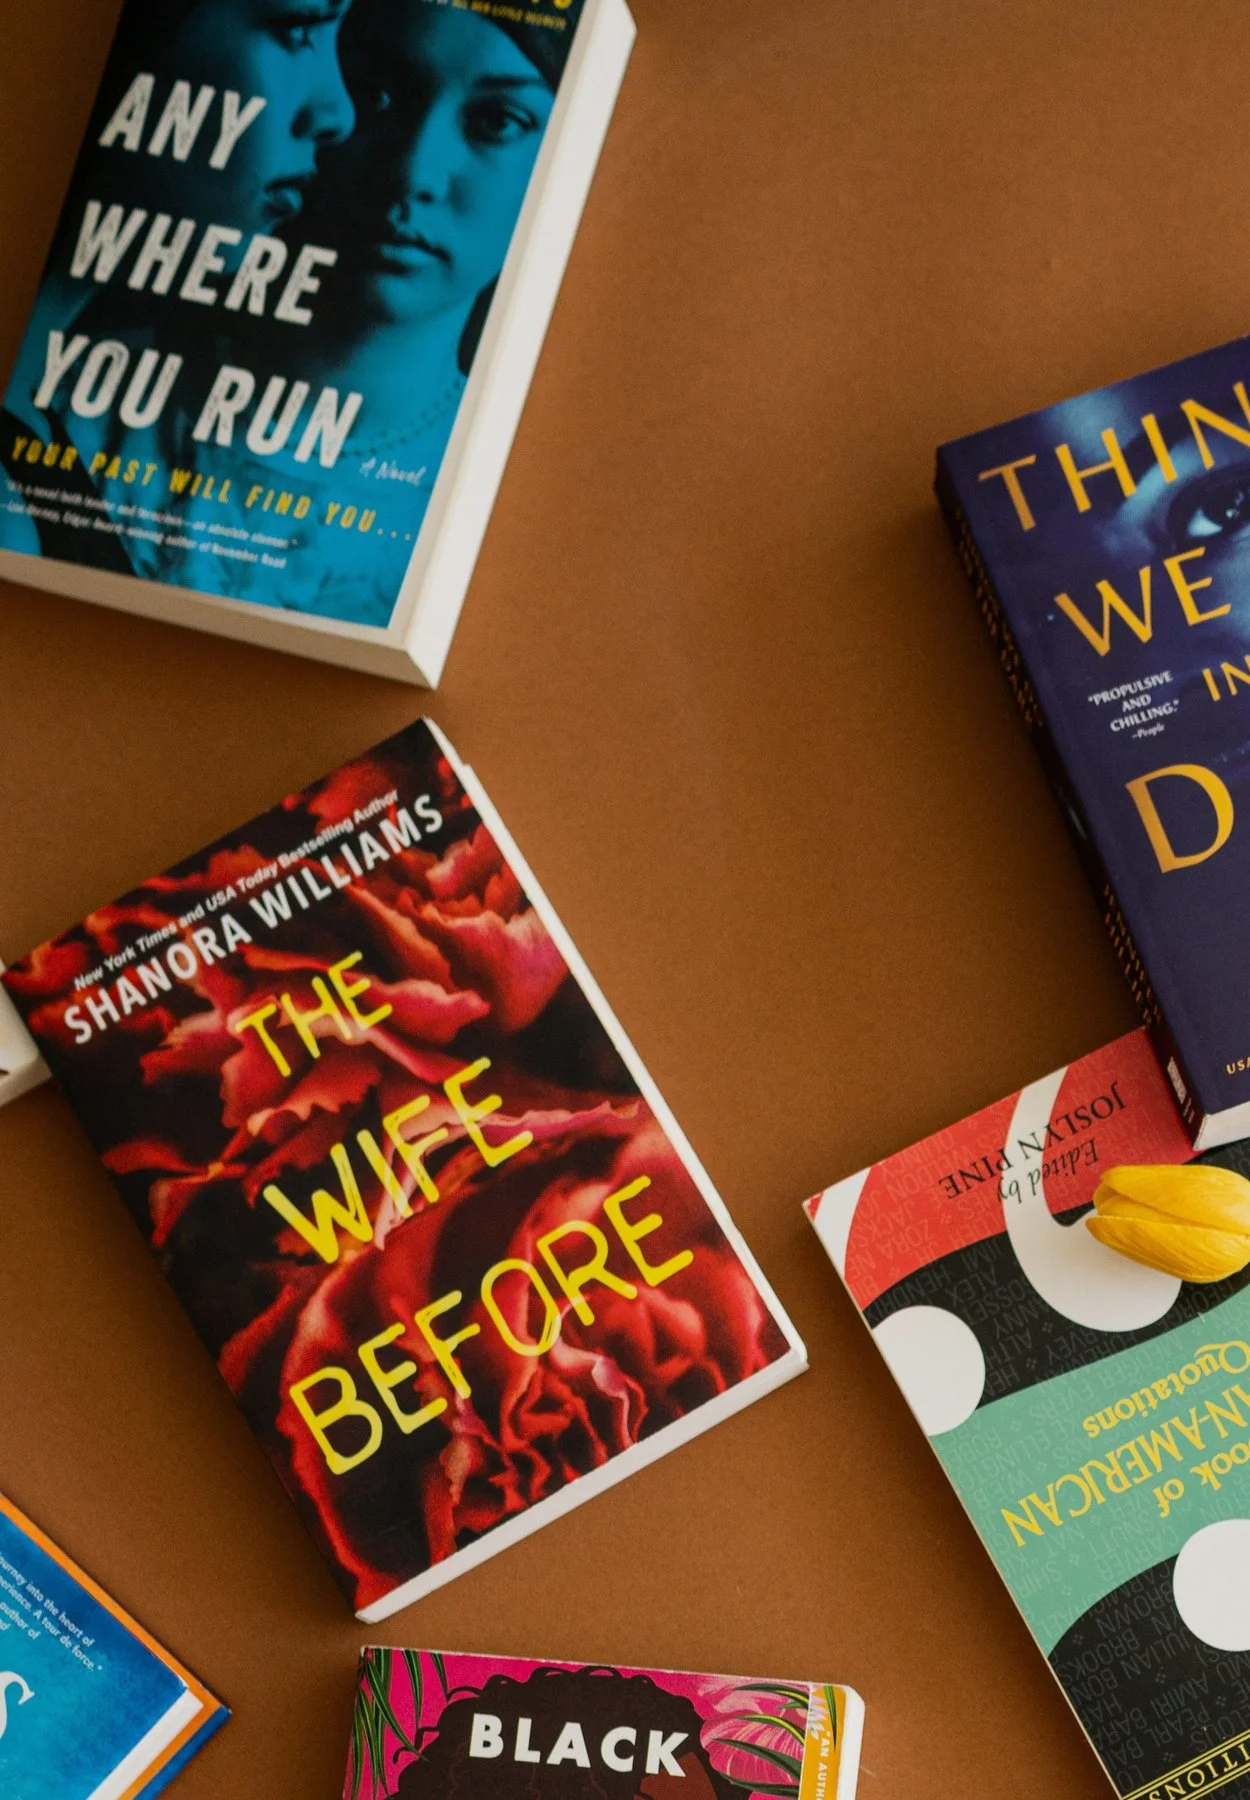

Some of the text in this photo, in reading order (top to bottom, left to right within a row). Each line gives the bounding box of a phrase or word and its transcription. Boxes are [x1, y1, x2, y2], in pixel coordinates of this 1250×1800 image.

[100, 74, 268, 169] ANY
[71, 202, 338, 325] WHERE
[34, 331, 364, 469] YOU RUN
[11, 436, 79, 472] YOUR
[87, 450, 159, 487] PAST
[167, 467, 232, 504] WILL
[244, 483, 313, 520] FIND
[1055, 546, 1232, 657] WE
[1086, 669, 1174, 707] "PROPULSIVE
[1121, 692, 1153, 714] AND
[64, 794, 443, 1044] SHANORA WILLIAMS
[73, 788, 399, 993] New York Times and USA Today Bestselling Author
[233, 951, 393, 1077] THE
[262, 1058, 534, 1262] WIFE
[940, 1080, 1129, 1200] JOSLYN PINE
[995, 1136, 1100, 1205] Edited by
[288, 1176, 695, 1475] BEFORE
[1152, 1476, 1186, 1519] of
[26, 1580, 95, 1648] into the heart of
[468, 1712, 690, 1778] BLACK
